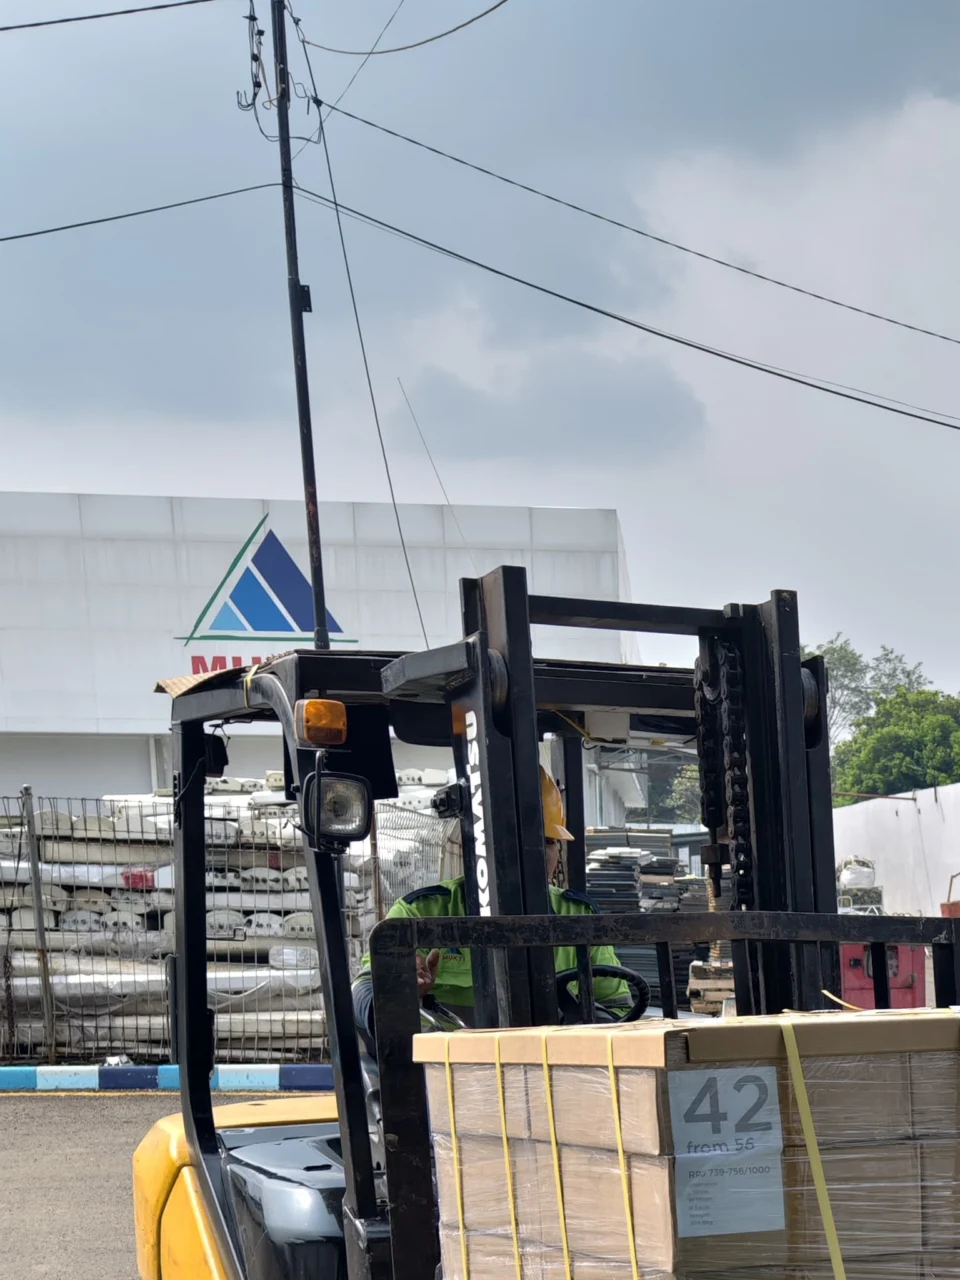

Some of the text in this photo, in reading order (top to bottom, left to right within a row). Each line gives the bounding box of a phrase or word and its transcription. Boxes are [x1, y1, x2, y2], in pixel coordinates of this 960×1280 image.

[464, 710, 492, 917] KOMATSU
[683, 1074, 773, 1135] 42
[686, 1137, 755, 1155] from 56
